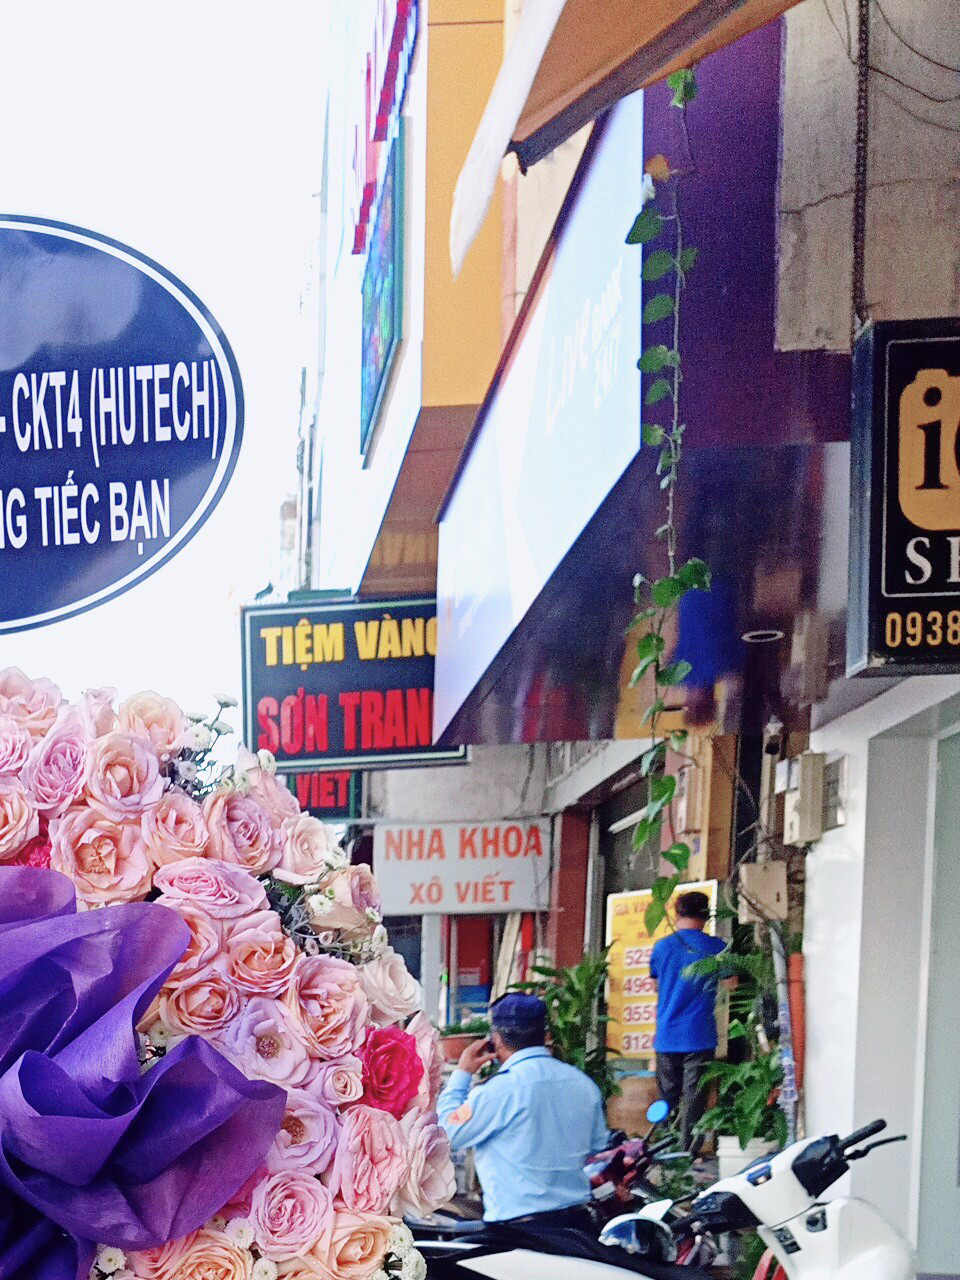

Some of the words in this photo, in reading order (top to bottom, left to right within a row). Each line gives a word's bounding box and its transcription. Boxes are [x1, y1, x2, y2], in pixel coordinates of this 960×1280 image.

[12, 369, 83, 453] CKT4
[90, 359, 220, 468] (HUTECH)
[34, 470, 100, 549] TIẾC
[108, 478, 172, 556] BẠN
[260, 617, 346, 672] TIỆM
[885, 609, 960, 648] 0938
[257, 687, 329, 756] SƠN
[339, 687, 435, 750] TRAN
[384, 828, 446, 861] NHA
[458, 825, 543, 860] KHOA
[409, 875, 444, 906] XÔ
[455, 872, 516, 905] VIẾT
